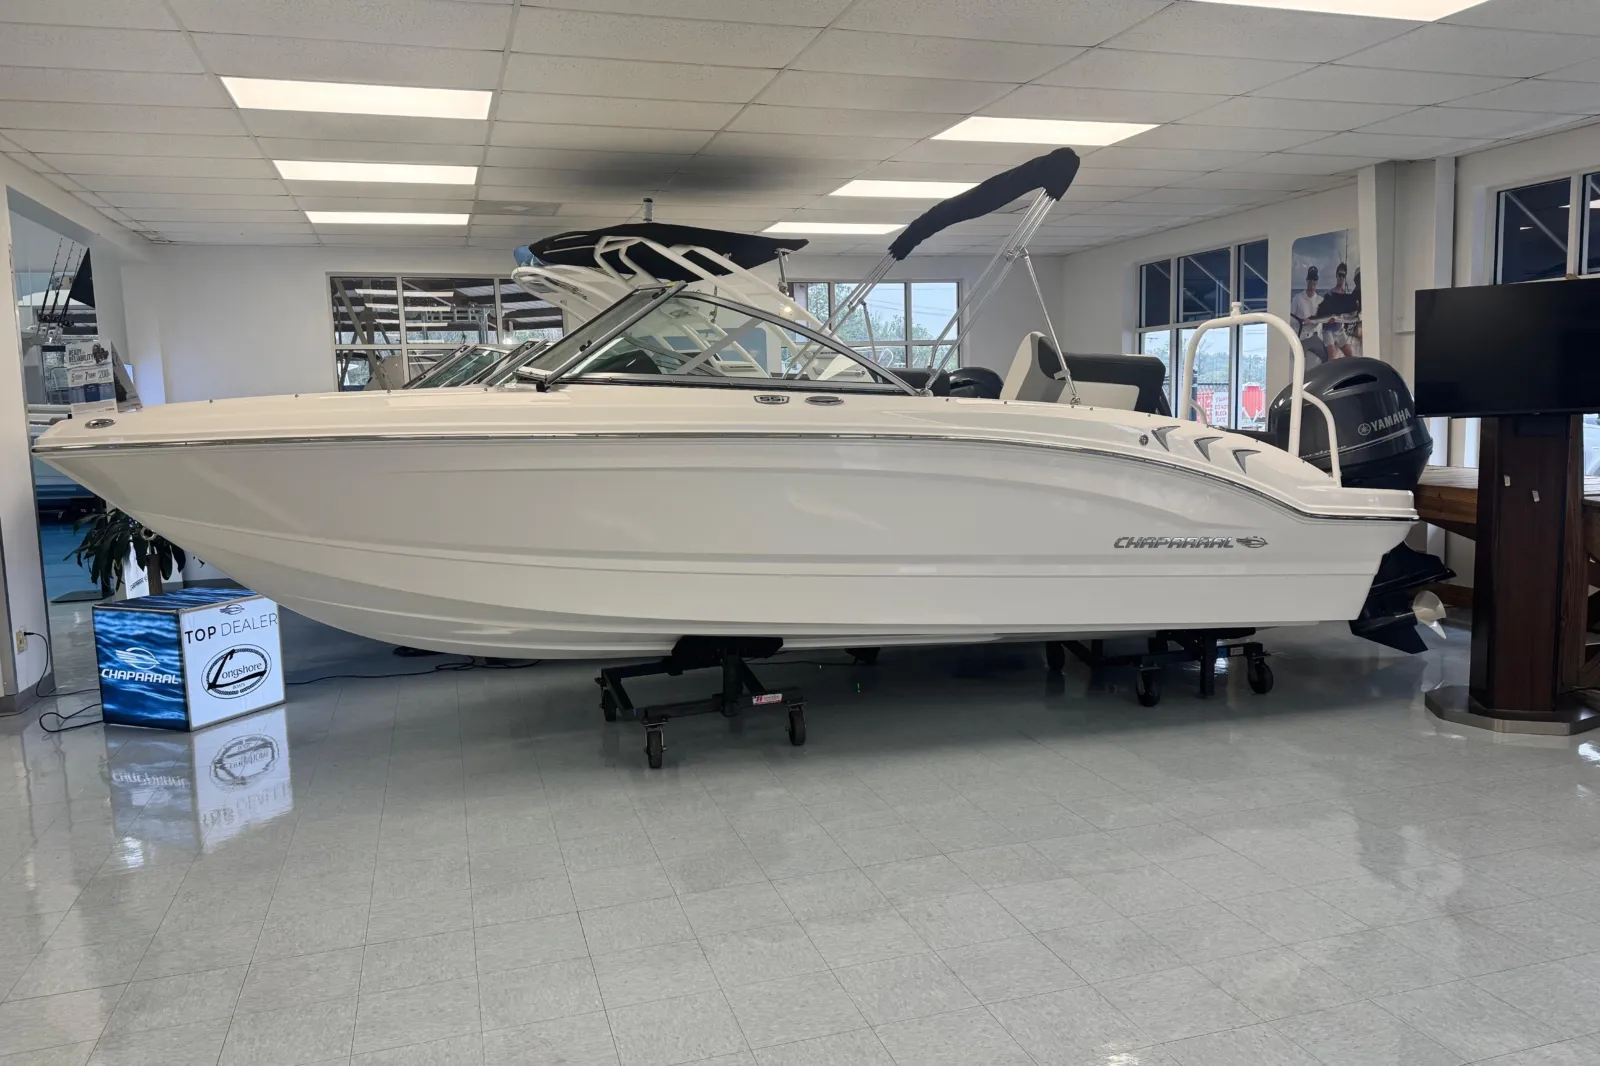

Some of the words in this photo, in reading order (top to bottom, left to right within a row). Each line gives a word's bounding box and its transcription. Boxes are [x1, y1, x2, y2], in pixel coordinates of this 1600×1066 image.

[1370, 408, 1412, 432] YAMAHA
[1113, 536, 1234, 548] CHAPARRAL
[184, 626, 216, 644] TOP
[222, 613, 278, 637] DEALER
[101, 668, 179, 684] CHAPARRAL
[207, 648, 266, 690] Longshore
